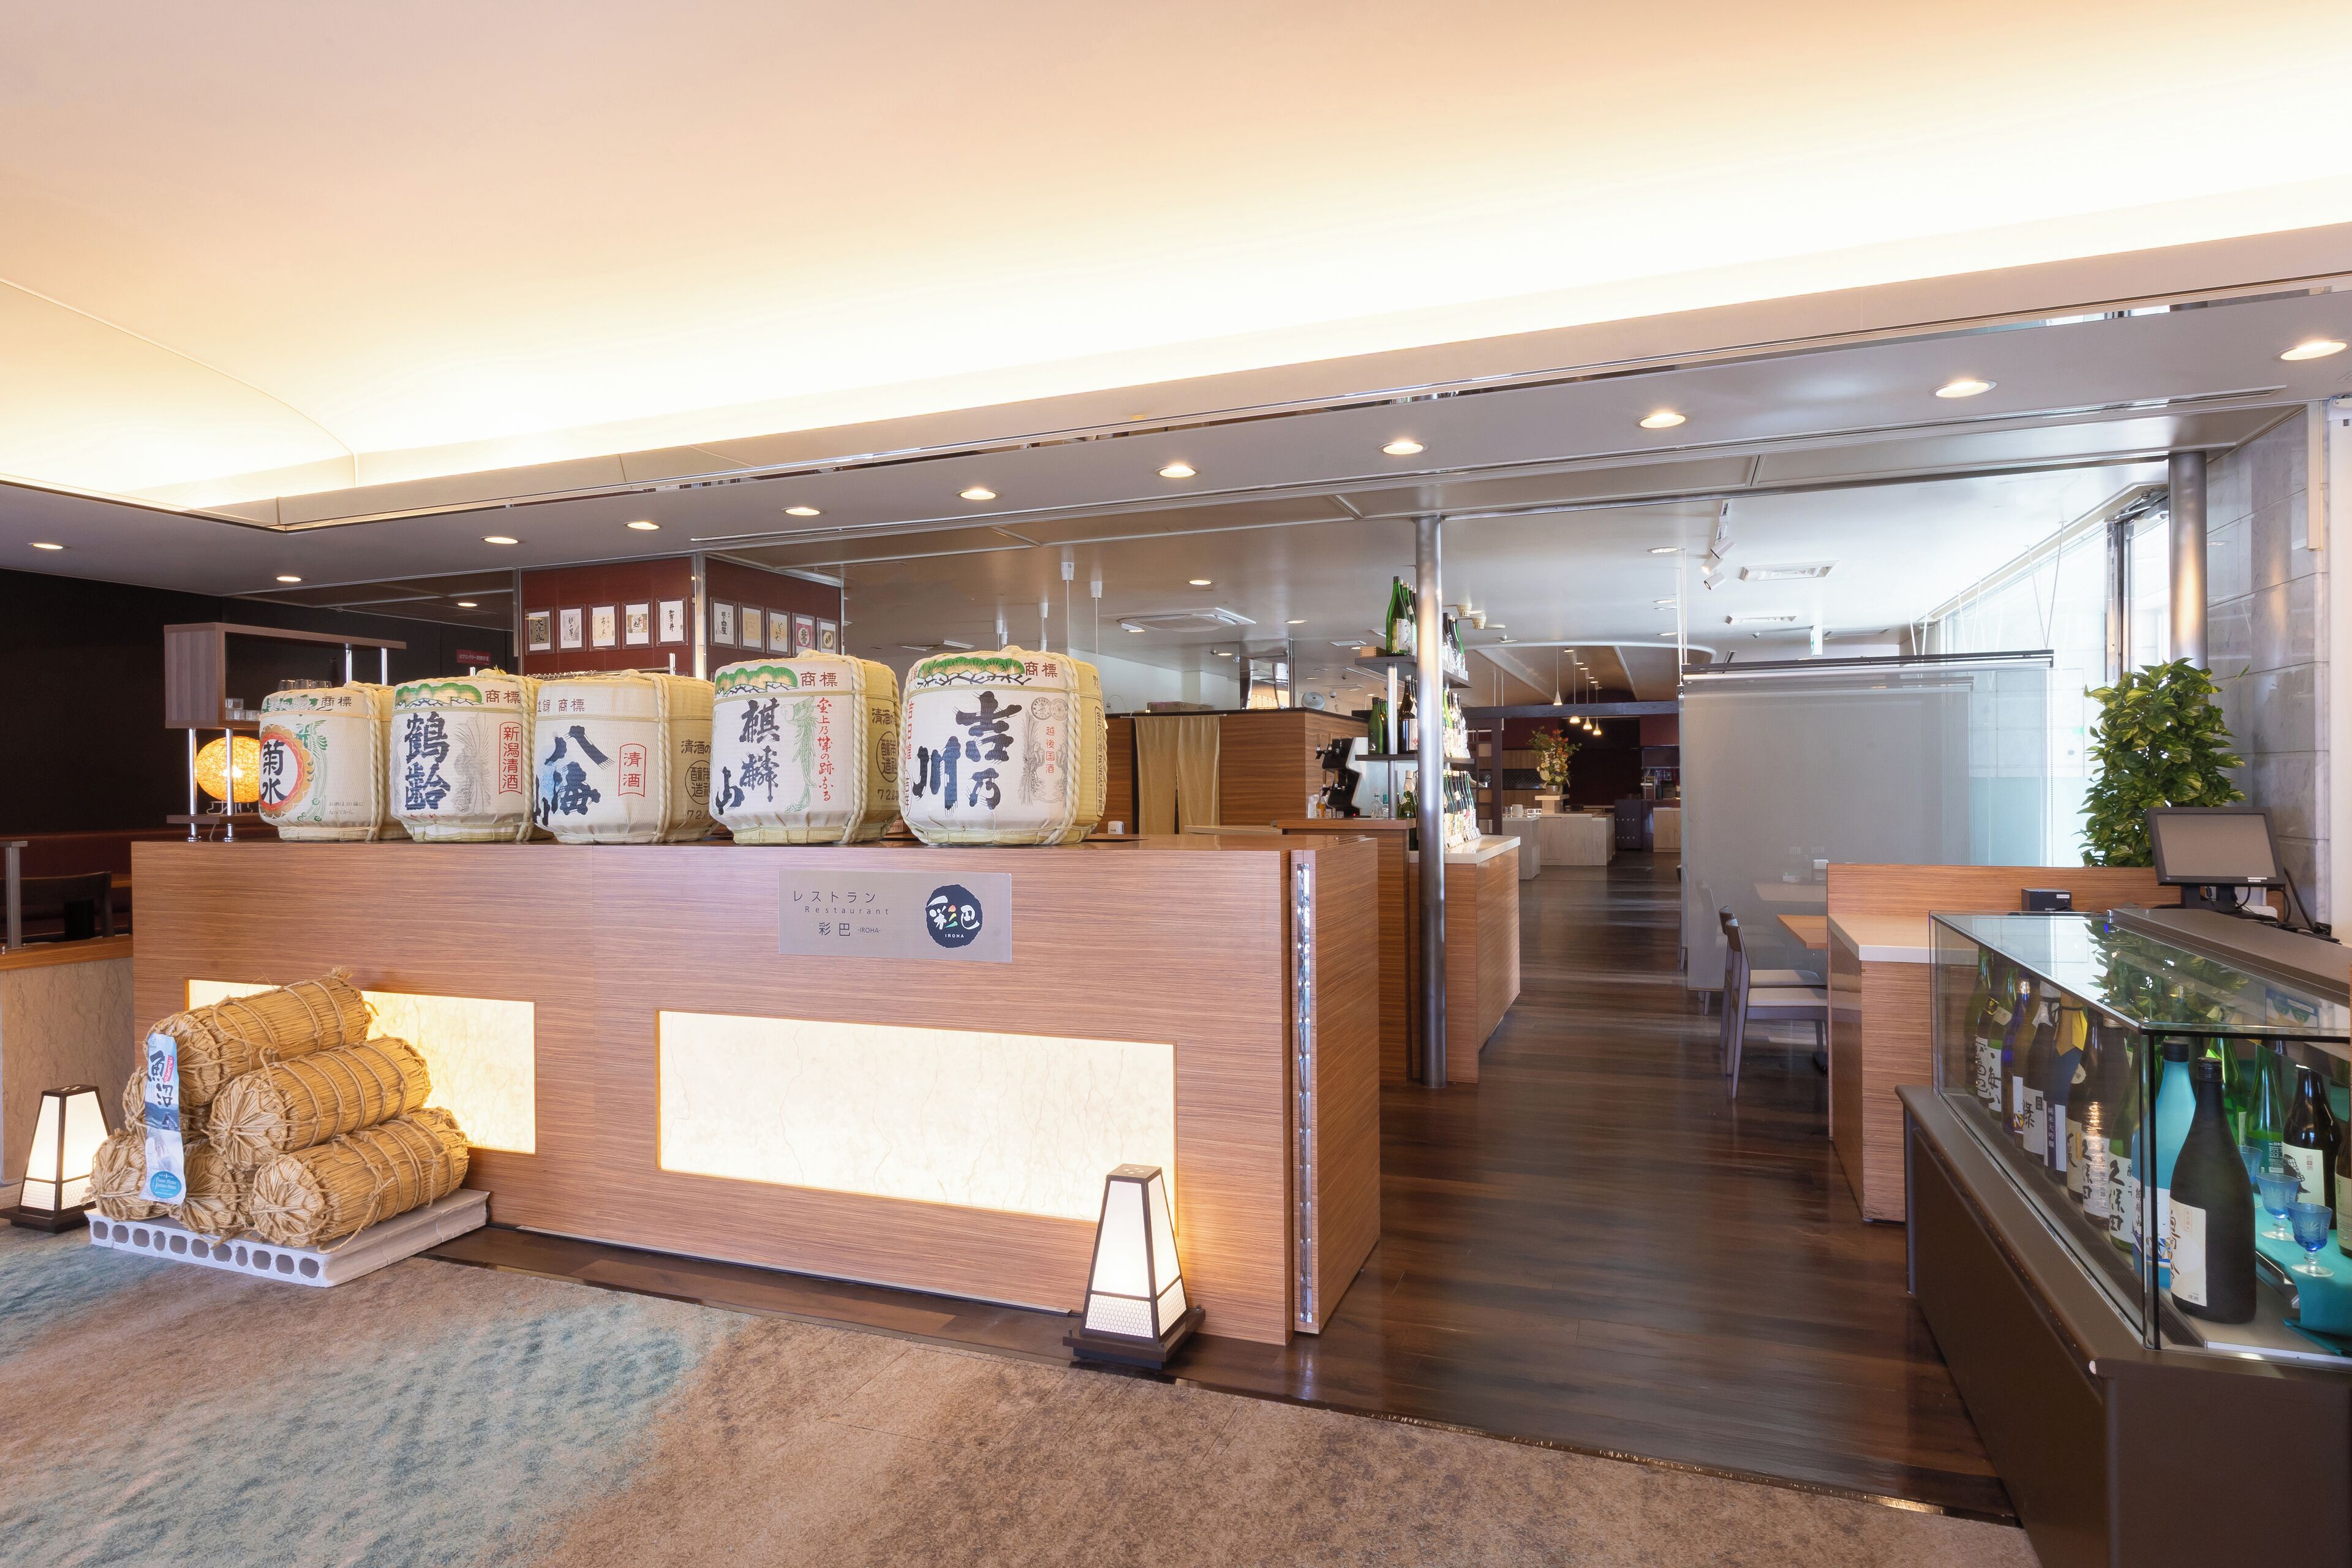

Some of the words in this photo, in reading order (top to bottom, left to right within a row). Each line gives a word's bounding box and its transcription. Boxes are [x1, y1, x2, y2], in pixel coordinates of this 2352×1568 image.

[1023, 661, 1058, 678] 商標
[800, 671, 839, 687] 商標
[321, 696, 352, 707] 商標
[484, 689, 522, 704] 商標
[558, 698, 586, 712] 商標
[502, 726, 520, 790] 新潟清酒
[1045, 726, 1055, 774] 越後国酒
[261, 739, 287, 806] 菊水
[623, 751, 642, 788] 清酒
[794, 890, 876, 903] レストラン
[805, 905, 889, 916] Restaurant
[148, 1049, 174, 1108] 魚沼
[2108, 1159, 2125, 1231] 久保田
